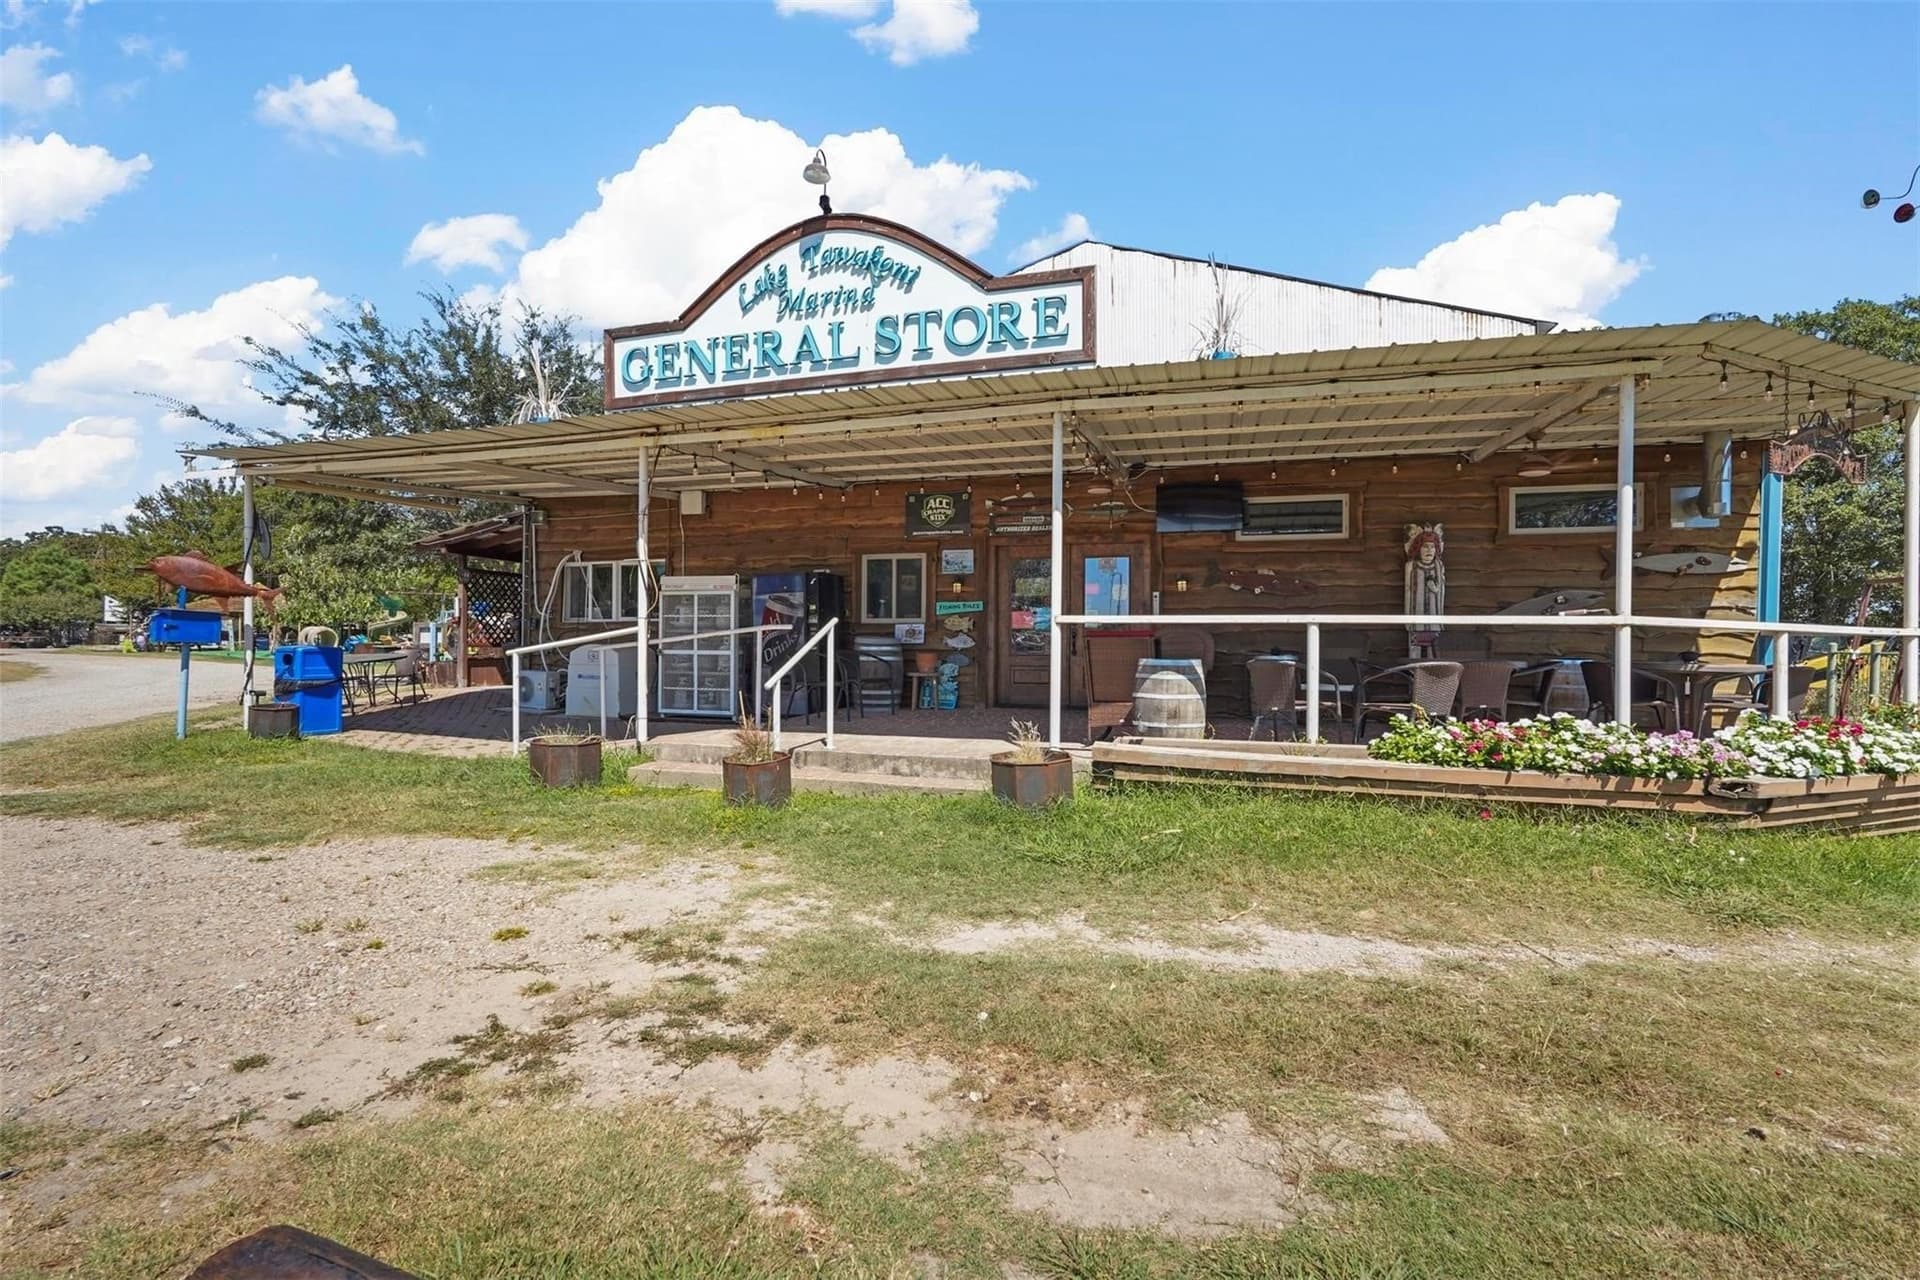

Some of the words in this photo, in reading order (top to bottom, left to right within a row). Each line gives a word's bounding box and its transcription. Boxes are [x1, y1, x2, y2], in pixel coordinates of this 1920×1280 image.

[739, 263, 789, 314] Lake
[801, 243, 921, 288] Tawakoni
[778, 284, 876, 316] Marina
[621, 321, 860, 385] GENERAL
[875, 294, 1070, 357] STORE
[927, 498, 950, 509] ACC
